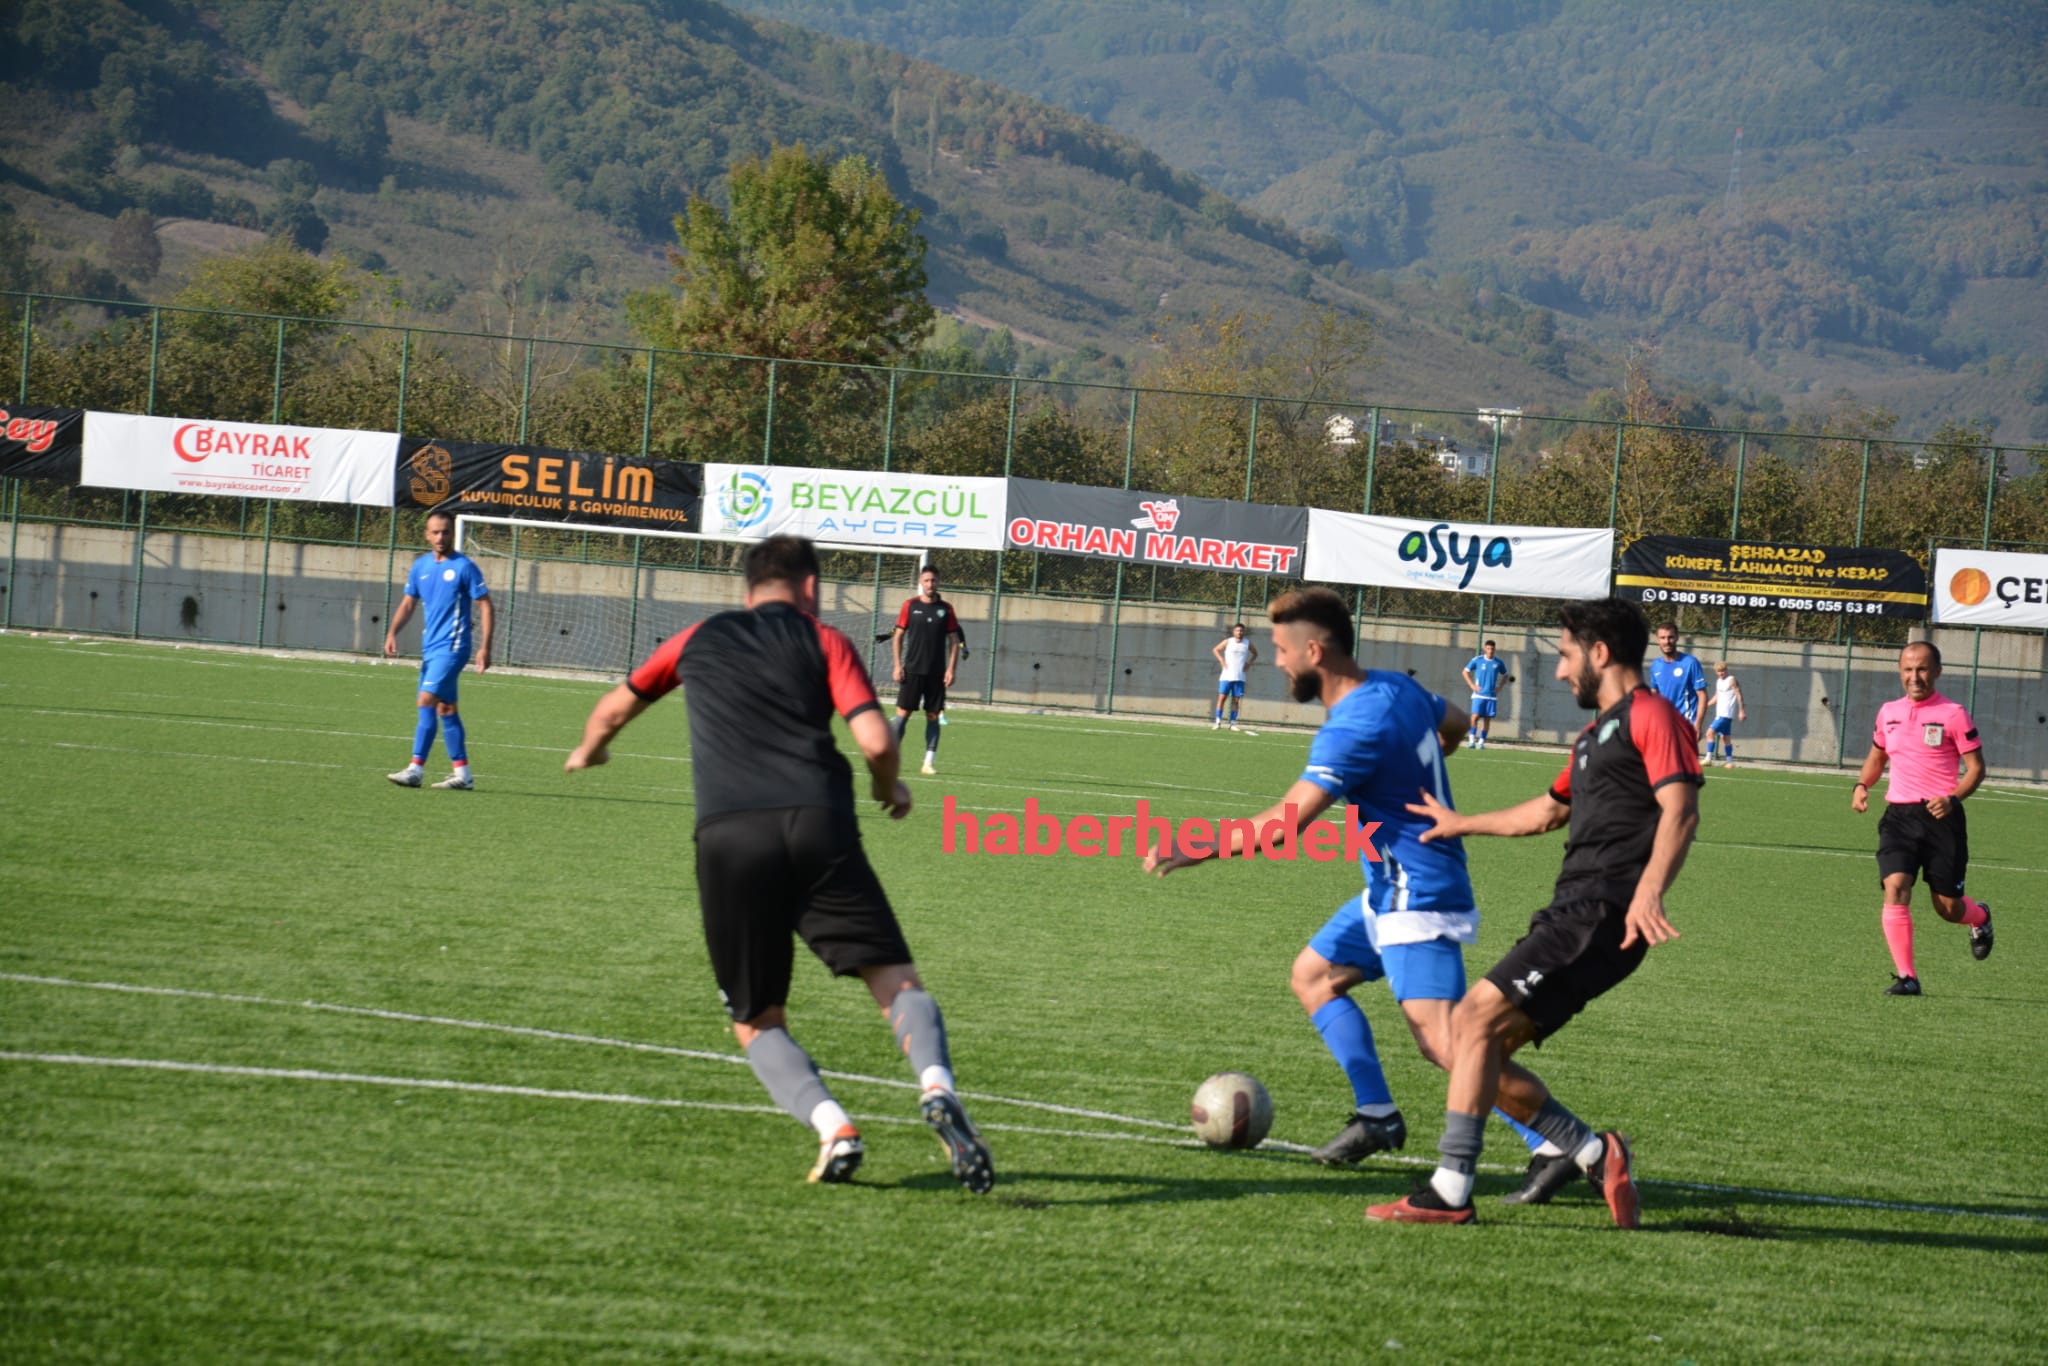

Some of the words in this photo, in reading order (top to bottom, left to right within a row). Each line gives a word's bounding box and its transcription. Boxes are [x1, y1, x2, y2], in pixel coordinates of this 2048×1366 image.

[195, 427, 311, 459] BAYRAK
[252, 462, 312, 480] TİCARET
[500, 454, 655, 503] SELİM
[460, 490, 562, 510] KUYUMCULUK
[568, 501, 578, 511] &
[581, 500, 689, 522] GAYRİMENKUL
[791, 482, 989, 519] BEYAZGÜL
[817, 517, 959, 538] AYGAZ
[1009, 518, 1137, 558] ORHAN
[1144, 532, 1298, 573] MARKET
[1399, 523, 1513, 589] asya
[1729, 545, 1826, 563] ŞEHRAZAD
[1665, 554, 1727, 572] KÜNEFE,
[1729, 561, 1815, 577] LAHMACUN
[1816, 568, 1835, 578] ve
[1837, 566, 1889, 581] KEBAP
[1658, 590, 1668, 601] 0
[1671, 591, 1696, 603] 380
[1700, 593, 1726, 605] 512
[1728, 595, 1746, 606] 80
[1749, 597, 1767, 608] 80
[1779, 599, 1813, 610] 0505
[1816, 601, 1842, 612] 055
[1866, 603, 1883, 614] 81
[1996, 576, 2048, 609] ÇE
